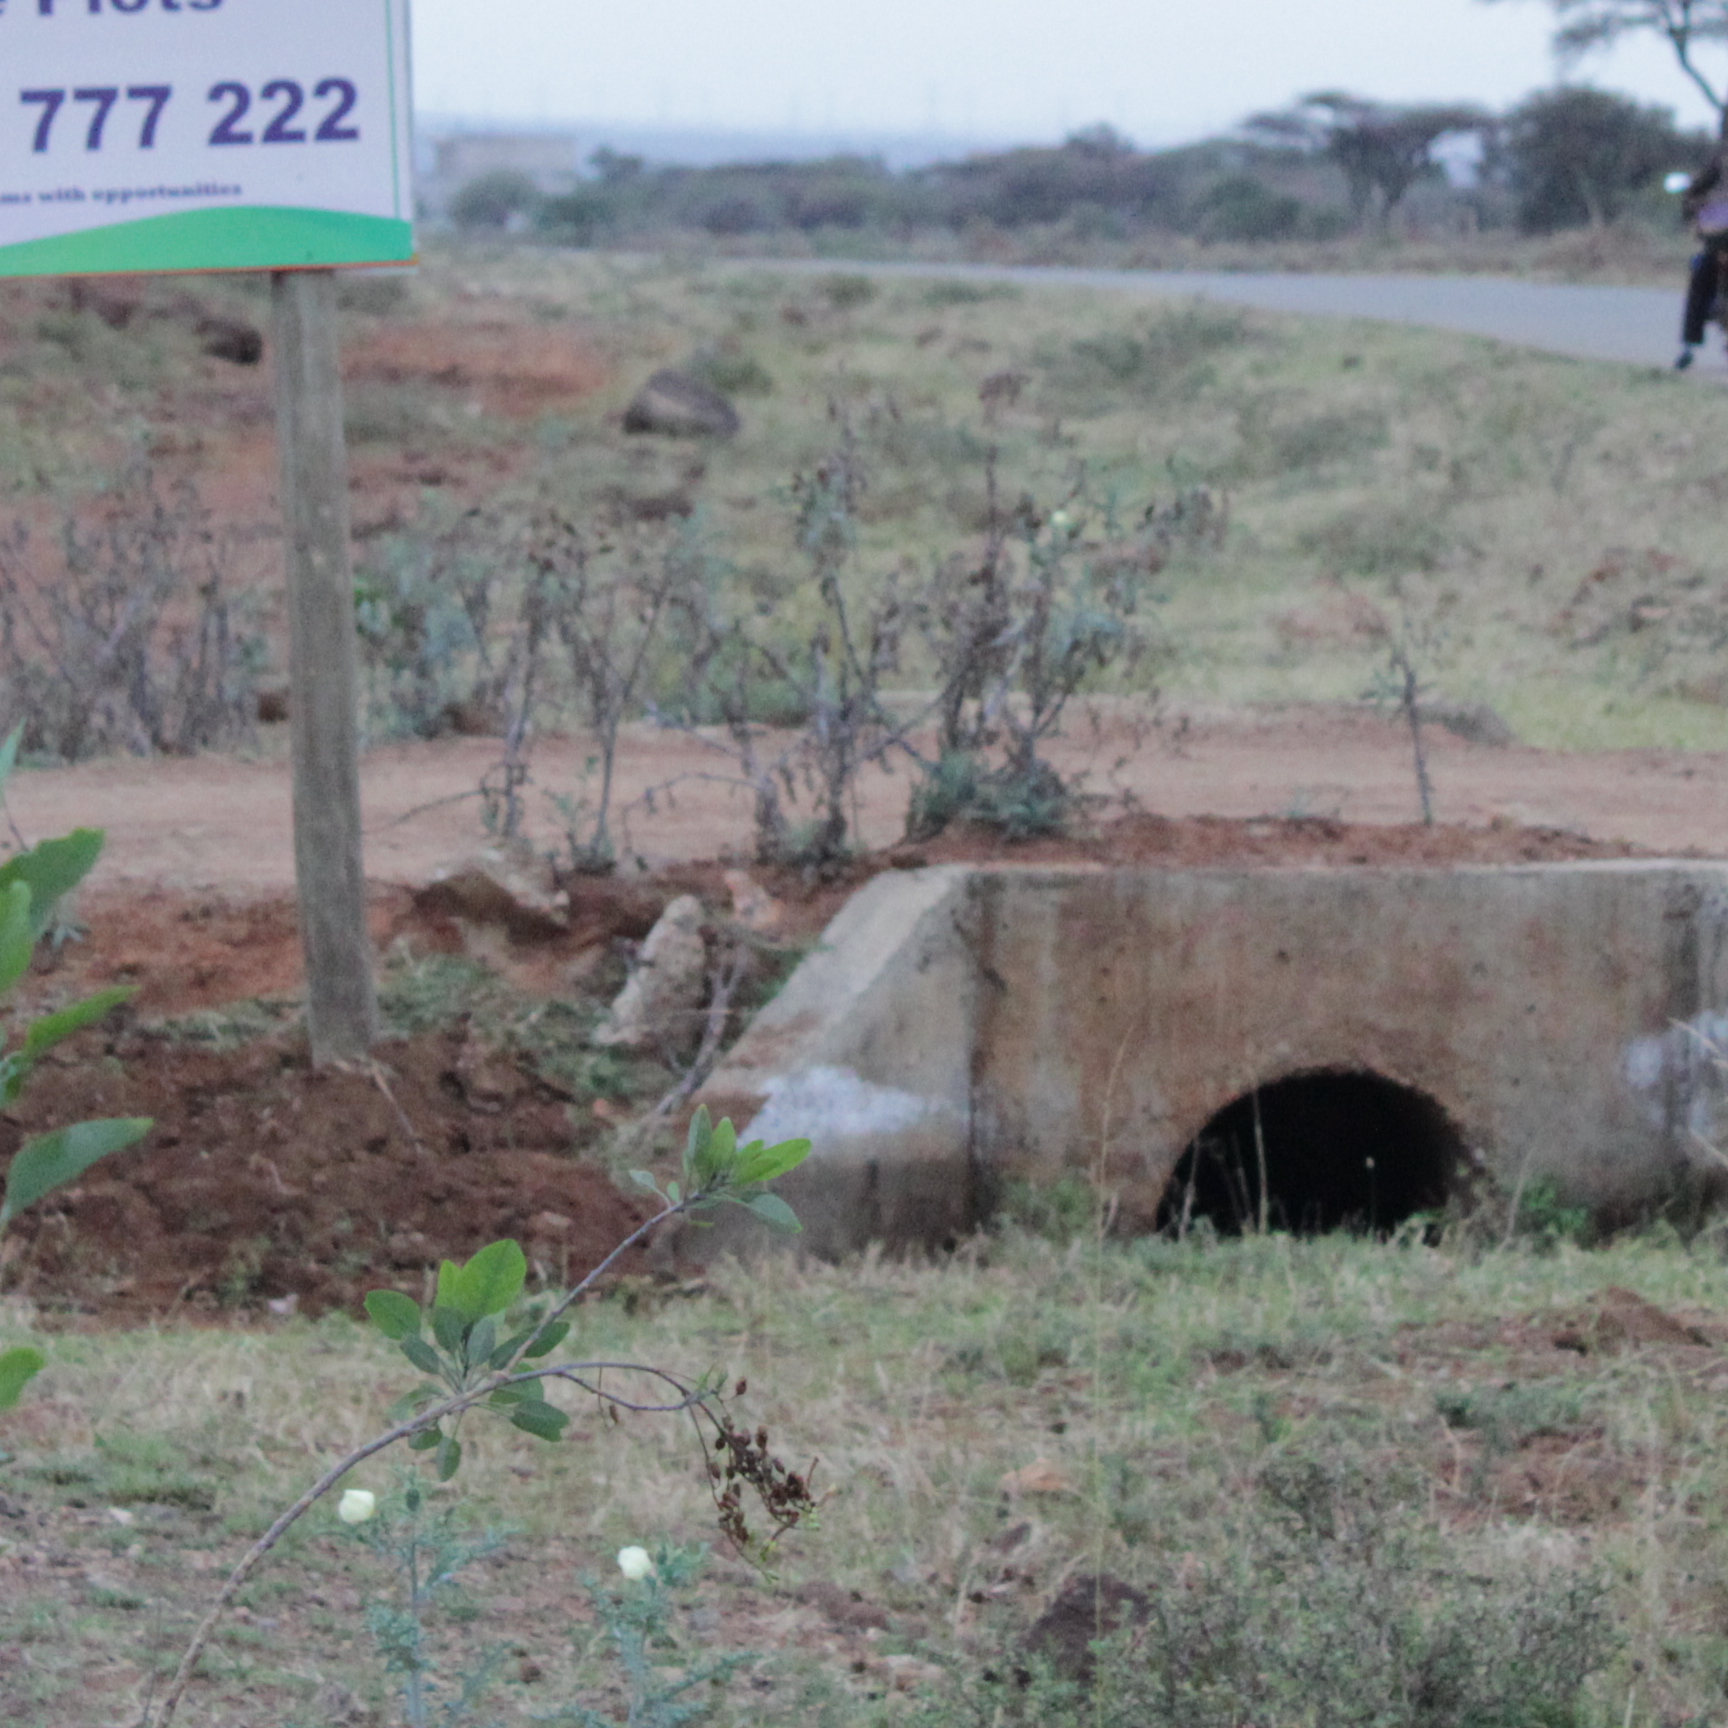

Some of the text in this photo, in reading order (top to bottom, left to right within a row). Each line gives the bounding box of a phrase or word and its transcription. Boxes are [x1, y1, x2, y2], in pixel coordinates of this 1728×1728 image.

[19, 84, 173, 154] 777
[207, 77, 361, 147] 222
[39, 185, 86, 203] with
